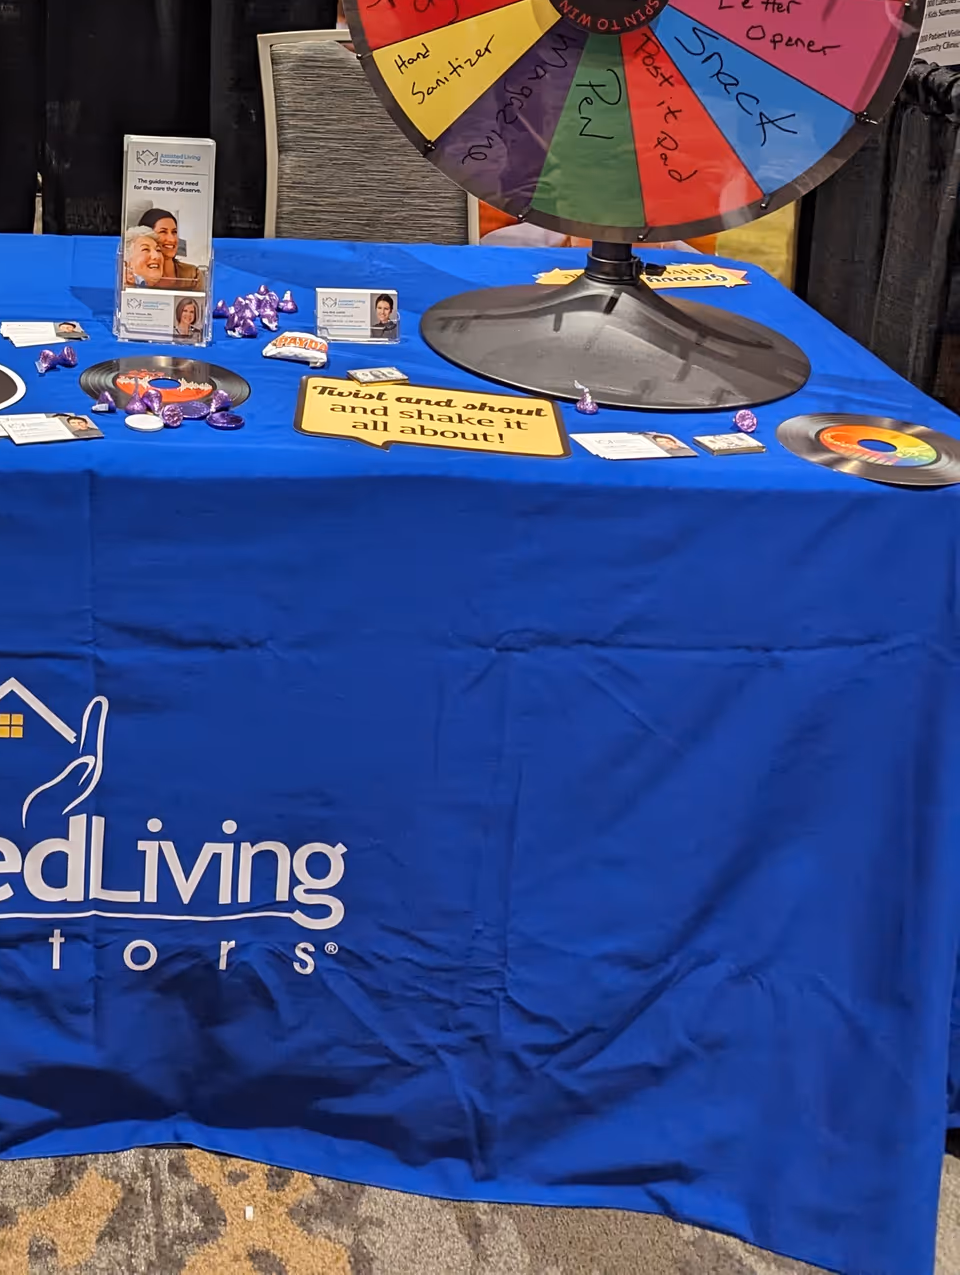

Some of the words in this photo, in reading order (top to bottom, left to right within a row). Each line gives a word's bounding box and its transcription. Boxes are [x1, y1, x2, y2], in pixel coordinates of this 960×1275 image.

[559, 0, 591, 27] WIN
[597, 19, 620, 31] TO
[746, 25, 841, 56] Opener
[394, 42, 431, 75] Hand
[411, 34, 495, 104] Sanitizer
[462, 33, 577, 165] Magazine
[633, 33, 675, 87] Post
[654, 130, 698, 183] Pad
[646, 274, 728, 286] Groovy
[312, 385, 388, 401] Twist
[395, 395, 457, 409] and
[462, 401, 548, 418] shout
[330, 403, 388, 417] and
[399, 408, 495, 427] shake
[351, 419, 390, 432] all
[399, 425, 505, 444] about!
